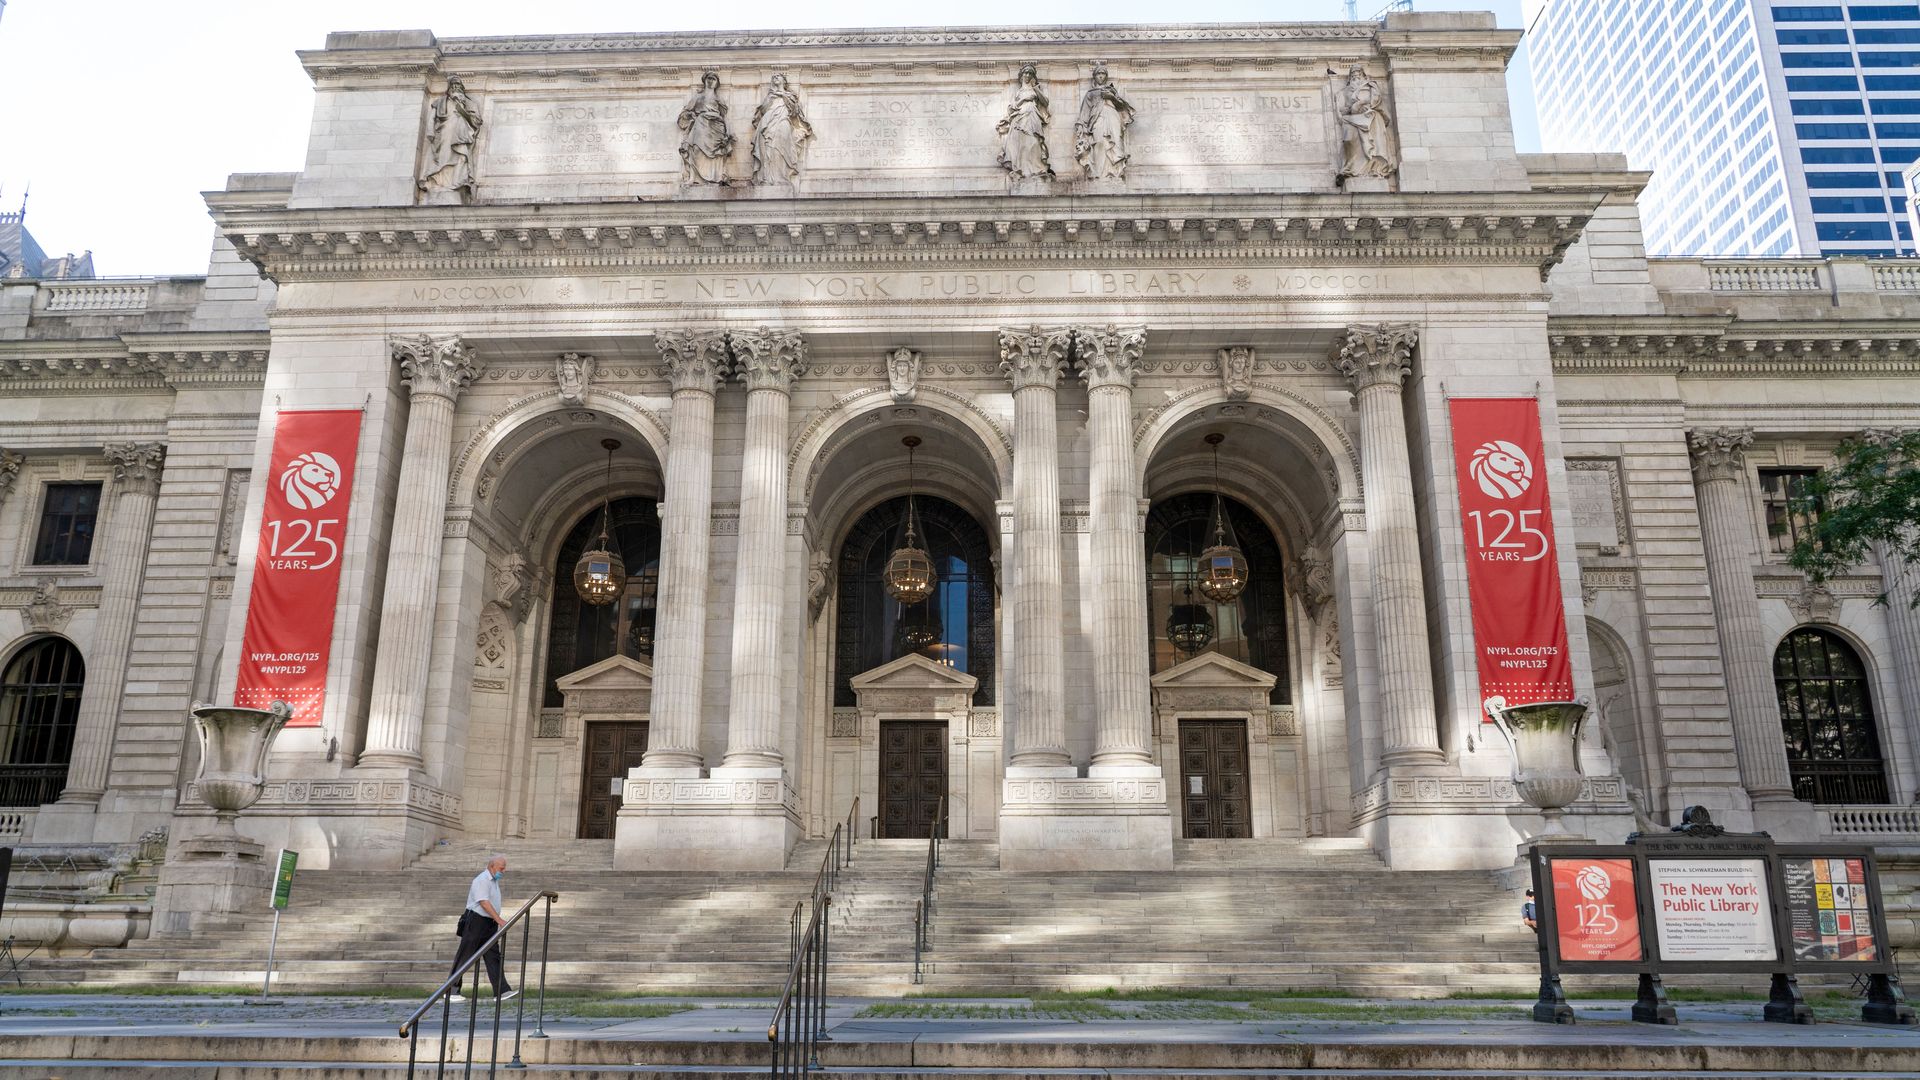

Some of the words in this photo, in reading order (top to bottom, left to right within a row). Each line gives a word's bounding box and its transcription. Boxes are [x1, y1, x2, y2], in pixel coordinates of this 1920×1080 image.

[818, 101, 849, 115] THE
[860, 100, 913, 114] LENOX
[921, 99, 992, 113] LIBRARY
[1137, 97, 1169, 111] THE
[1184, 97, 1245, 110] TILDEN
[1256, 96, 1312, 109] TRUST
[504, 108, 534, 121] THE
[545, 106, 597, 120] ASTOR
[605, 104, 673, 119] LIBRARY
[869, 119, 916, 127] FOUNDED
[1254, 123, 1298, 132] TILDEN
[552, 125, 598, 133] FOUNDED
[855, 128, 898, 138] JAMES
[911, 127, 953, 137] LENOX
[522, 134, 555, 144] JOHN
[560, 133, 602, 143] JACOB
[609, 132, 648, 142] ASTOR
[840, 140, 895, 148] DEDICATED
[924, 138, 968, 147] HISTORY
[1169, 135, 1199, 143] SERVE
[561, 145, 580, 153] FOR
[586, 144, 606, 152] THE
[814, 149, 879, 158] LITERATURE
[413, 286, 532, 302] MDCCCXCV
[602, 280, 669, 301] THE
[695, 278, 777, 299] NEW
[805, 276, 891, 298] YORK
[920, 273, 1036, 296] PUBLIC
[1067, 272, 1206, 295] LIBRARY
[1275, 275, 1389, 291] MDCCCCII
[1574, 502, 1603, 512] AWAY
[1467, 508, 1549, 563] 125
[268, 518, 341, 572] 125
[1479, 550, 1521, 561] YEARS
[270, 559, 309, 570] YEARS
[1487, 645, 1559, 657] NYPL.ORG/125
[251, 651, 321, 664] NYPL.ORG/125
[1499, 659, 1547, 670] #NYPL125
[260, 665, 307, 676] #NYPL125
[1660, 882, 1687, 896] The
[1691, 883, 1723, 896] New
[1726, 882, 1758, 896] York
[1663, 899, 1706, 912] Public
[1709, 898, 1759, 915] Library
[1574, 903, 1619, 935] 125
